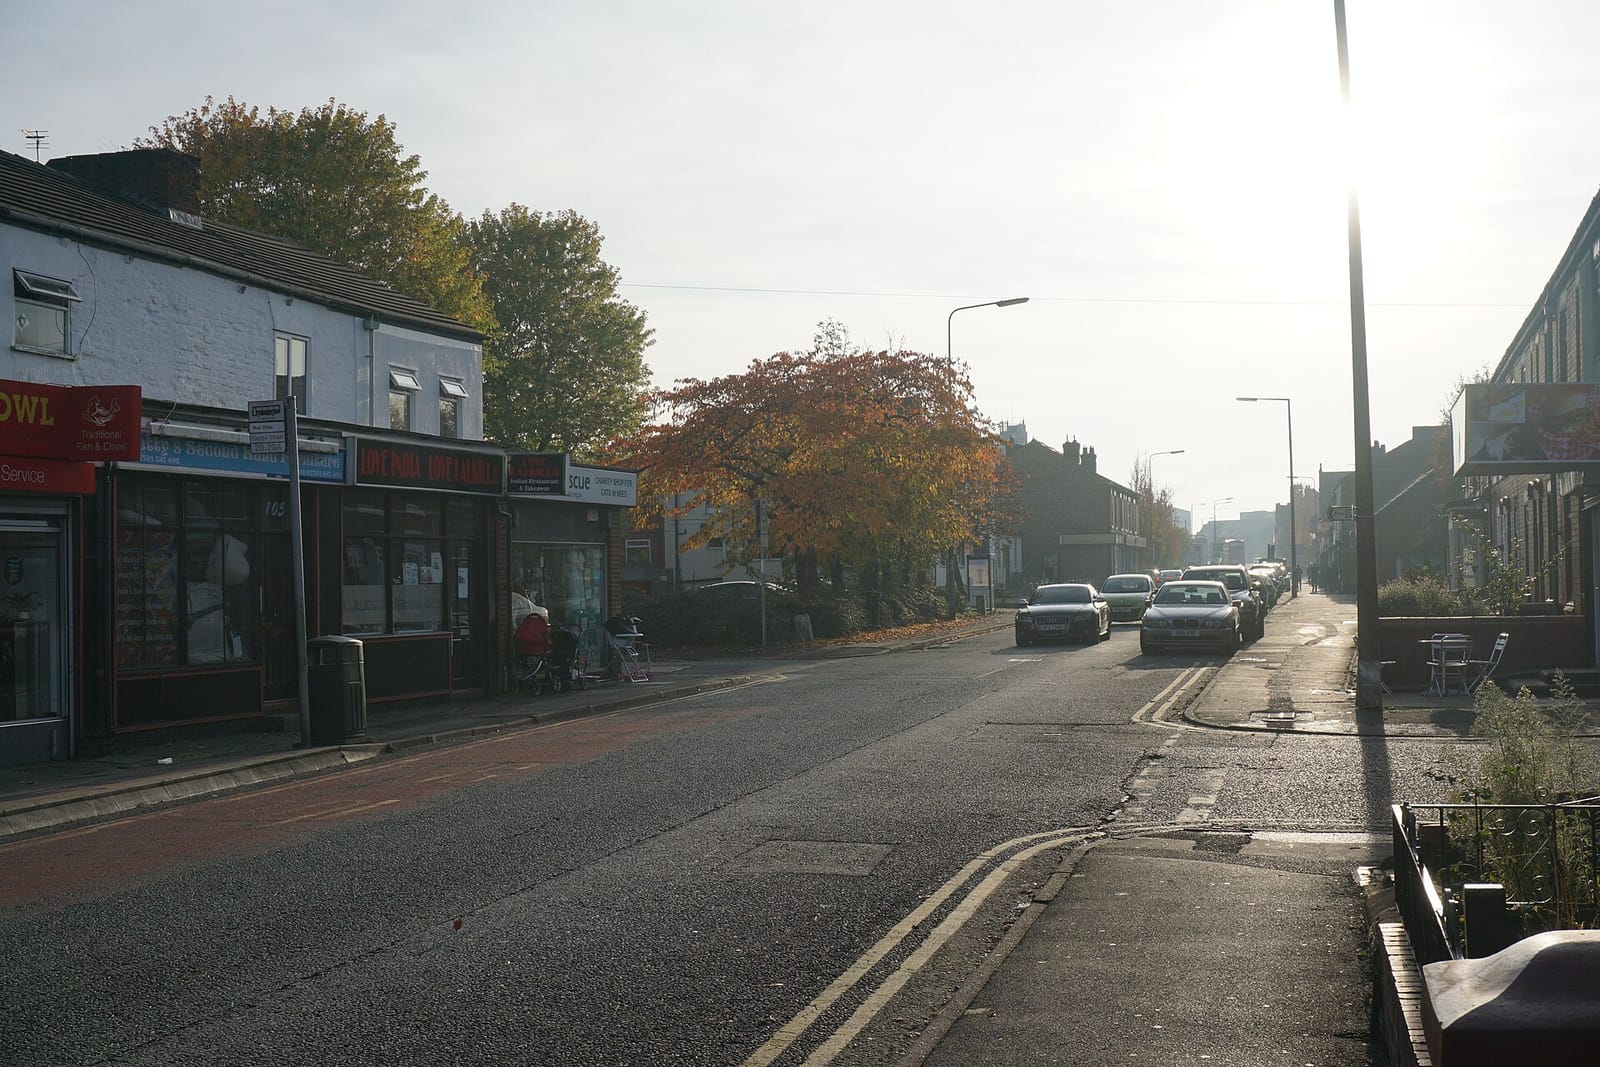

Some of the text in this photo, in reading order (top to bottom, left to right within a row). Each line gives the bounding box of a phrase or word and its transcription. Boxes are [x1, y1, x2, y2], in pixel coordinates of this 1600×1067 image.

[81, 429, 122, 439] Traditional
[76, 441, 126, 453] Fish & Chips
[186, 440, 239, 459] Second
[360, 447, 388, 478] LOVE
[390, 450, 422, 479] INDIA
[428, 454, 454, 481] LOVE
[1, 463, 45, 485] Service
[595, 476, 633, 487] CHARITY SHOP FOR
[601, 488, 611, 497] CATS
[265, 500, 286, 517] 105
